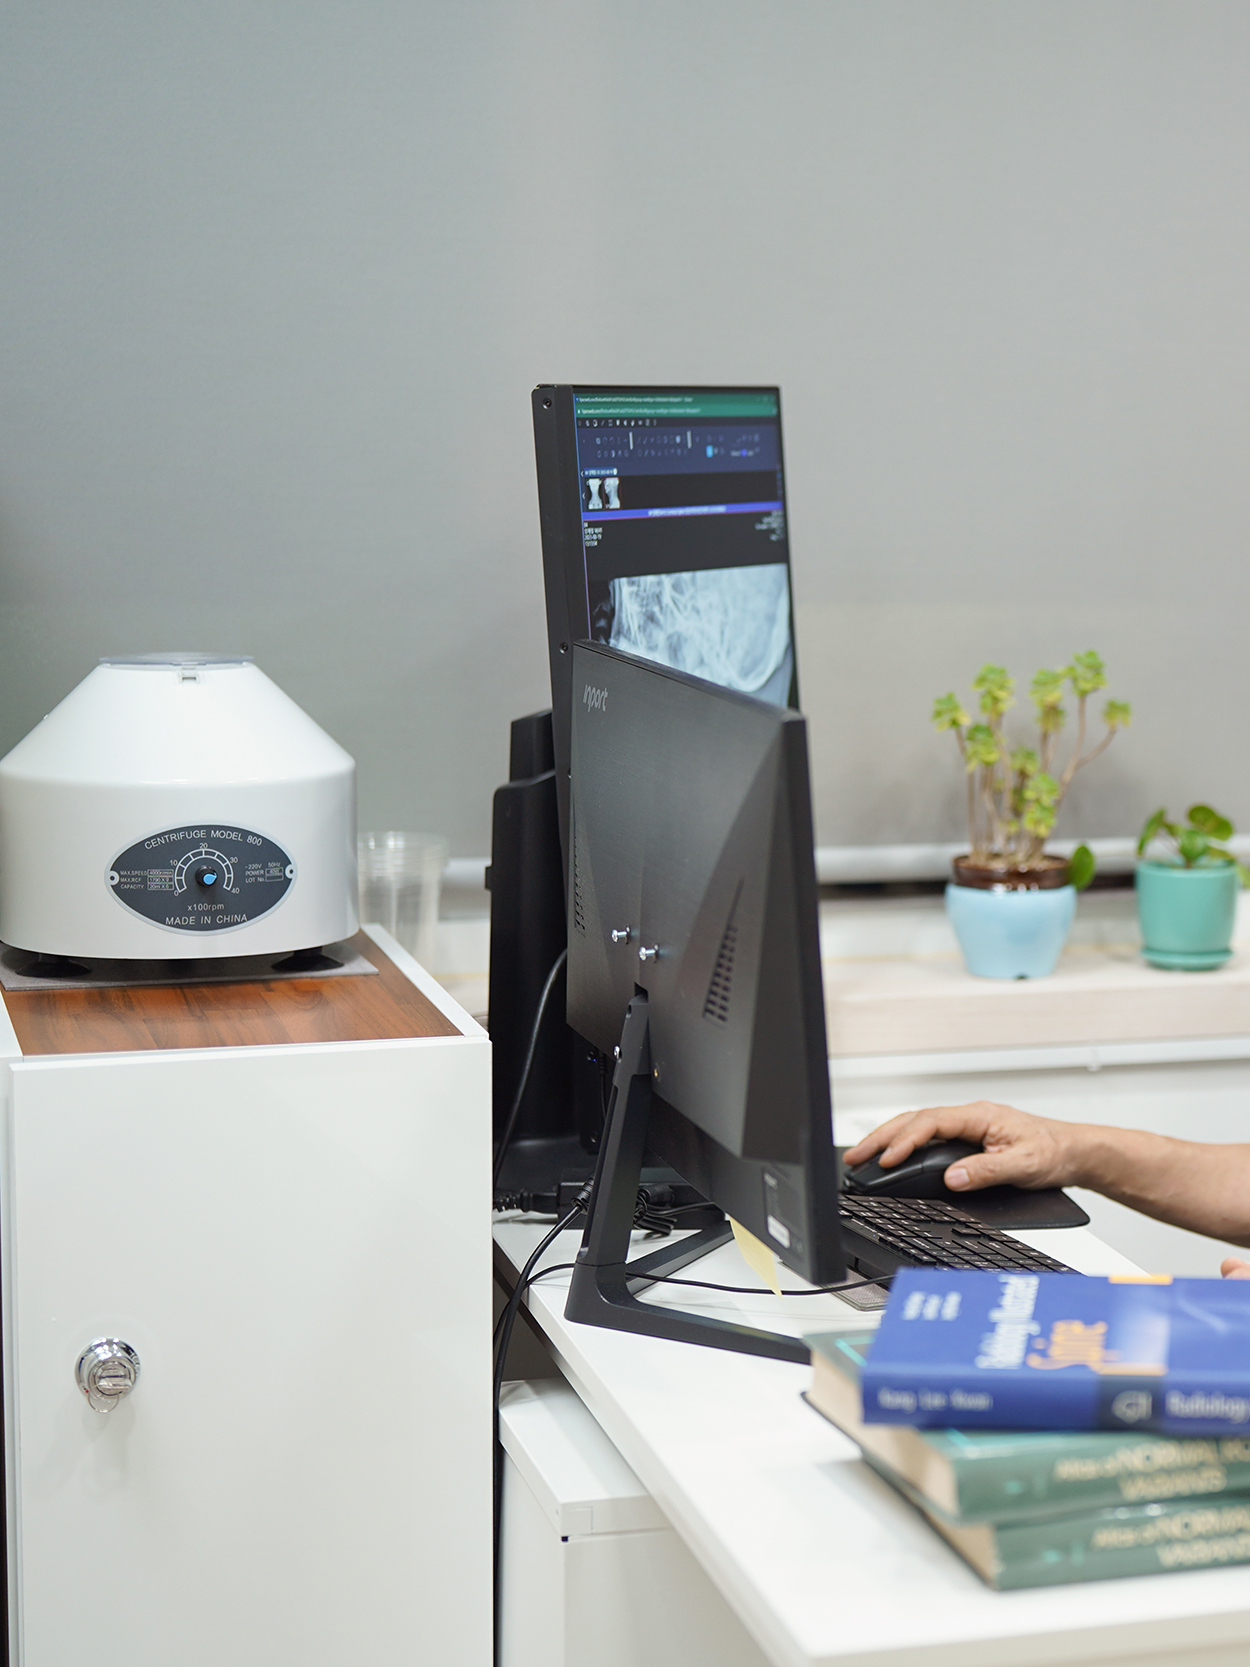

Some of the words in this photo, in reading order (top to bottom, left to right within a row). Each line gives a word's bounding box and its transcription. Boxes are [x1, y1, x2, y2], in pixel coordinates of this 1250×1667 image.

[144, 830, 207, 850] CENTRIFUGE
[210, 830, 243, 842] MODEL
[246, 835, 263, 847] 800
[229, 856, 239, 864] 30
[187, 903, 225, 912] x100rpm
[165, 916, 196, 926] MADE
[200, 916, 212, 924] IN
[216, 914, 248, 924] CHINA
